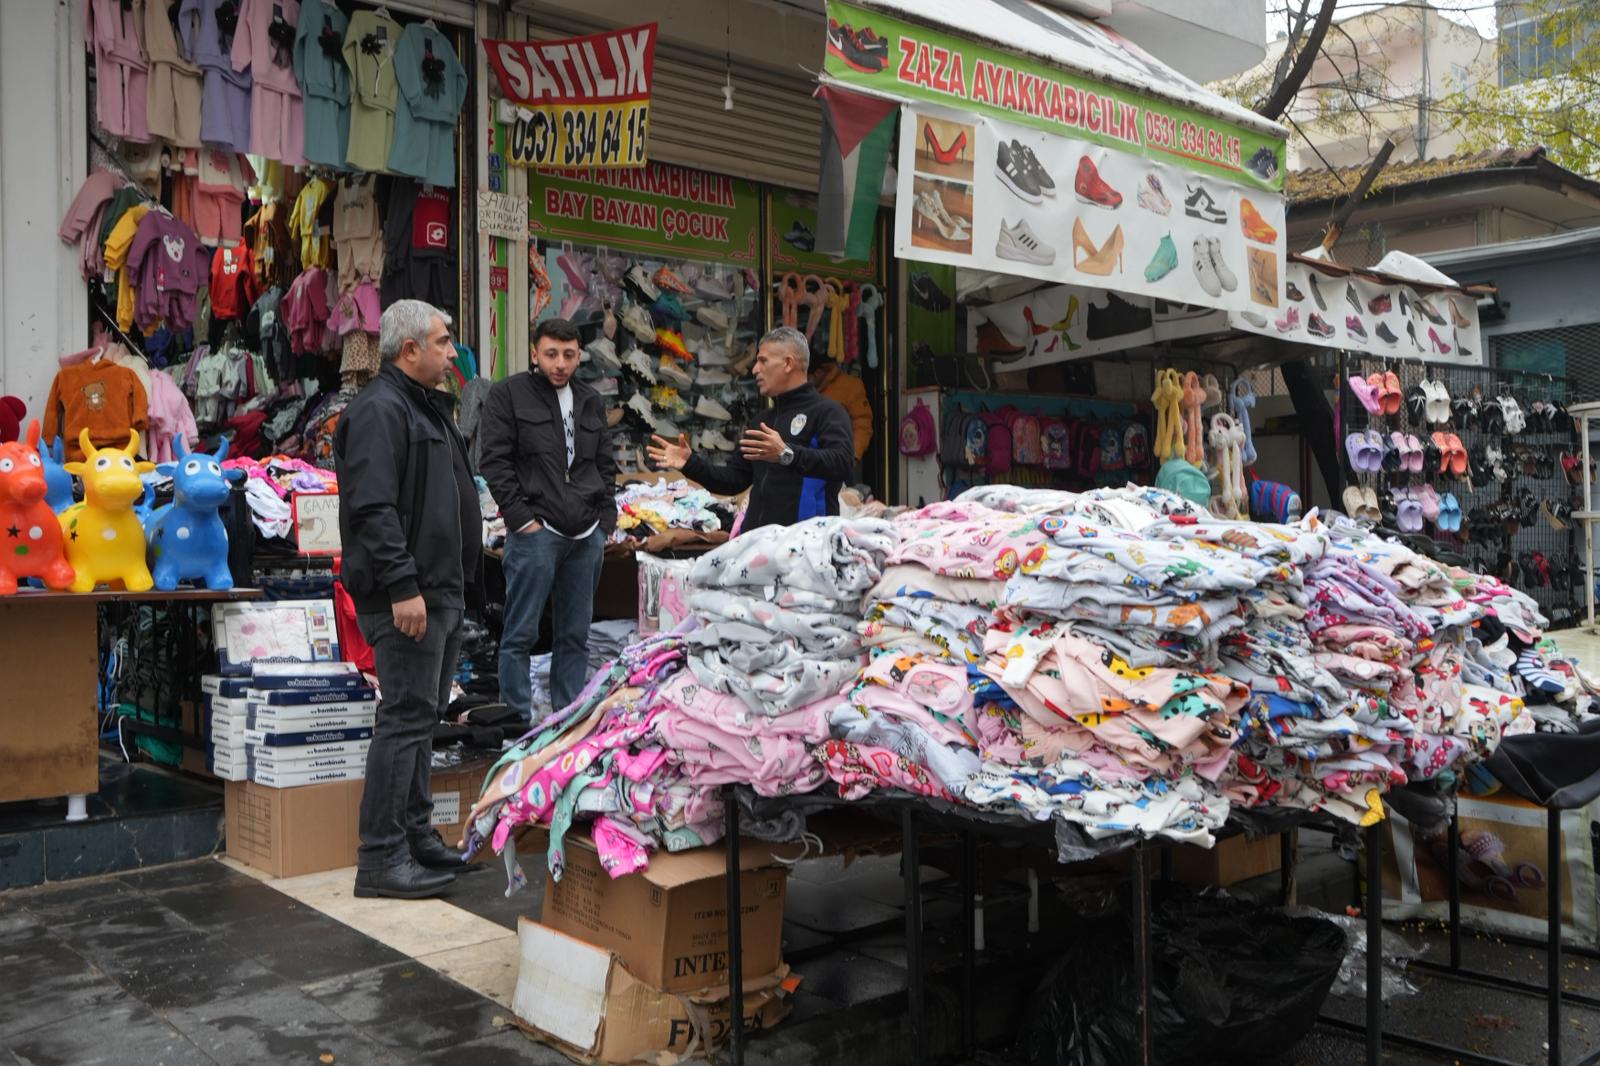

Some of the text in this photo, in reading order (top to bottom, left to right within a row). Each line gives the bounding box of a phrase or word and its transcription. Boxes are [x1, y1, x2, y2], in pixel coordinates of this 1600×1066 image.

[898, 36, 1240, 166] ZAZA AYAKKABICILIK 0531 334 64 15
[563, 110, 598, 164] 334
[601, 109, 622, 164] 64
[628, 108, 647, 162] 15
[545, 187, 728, 241] BAY BAYAN ÇOCUK
[674, 951, 740, 978] INTE
